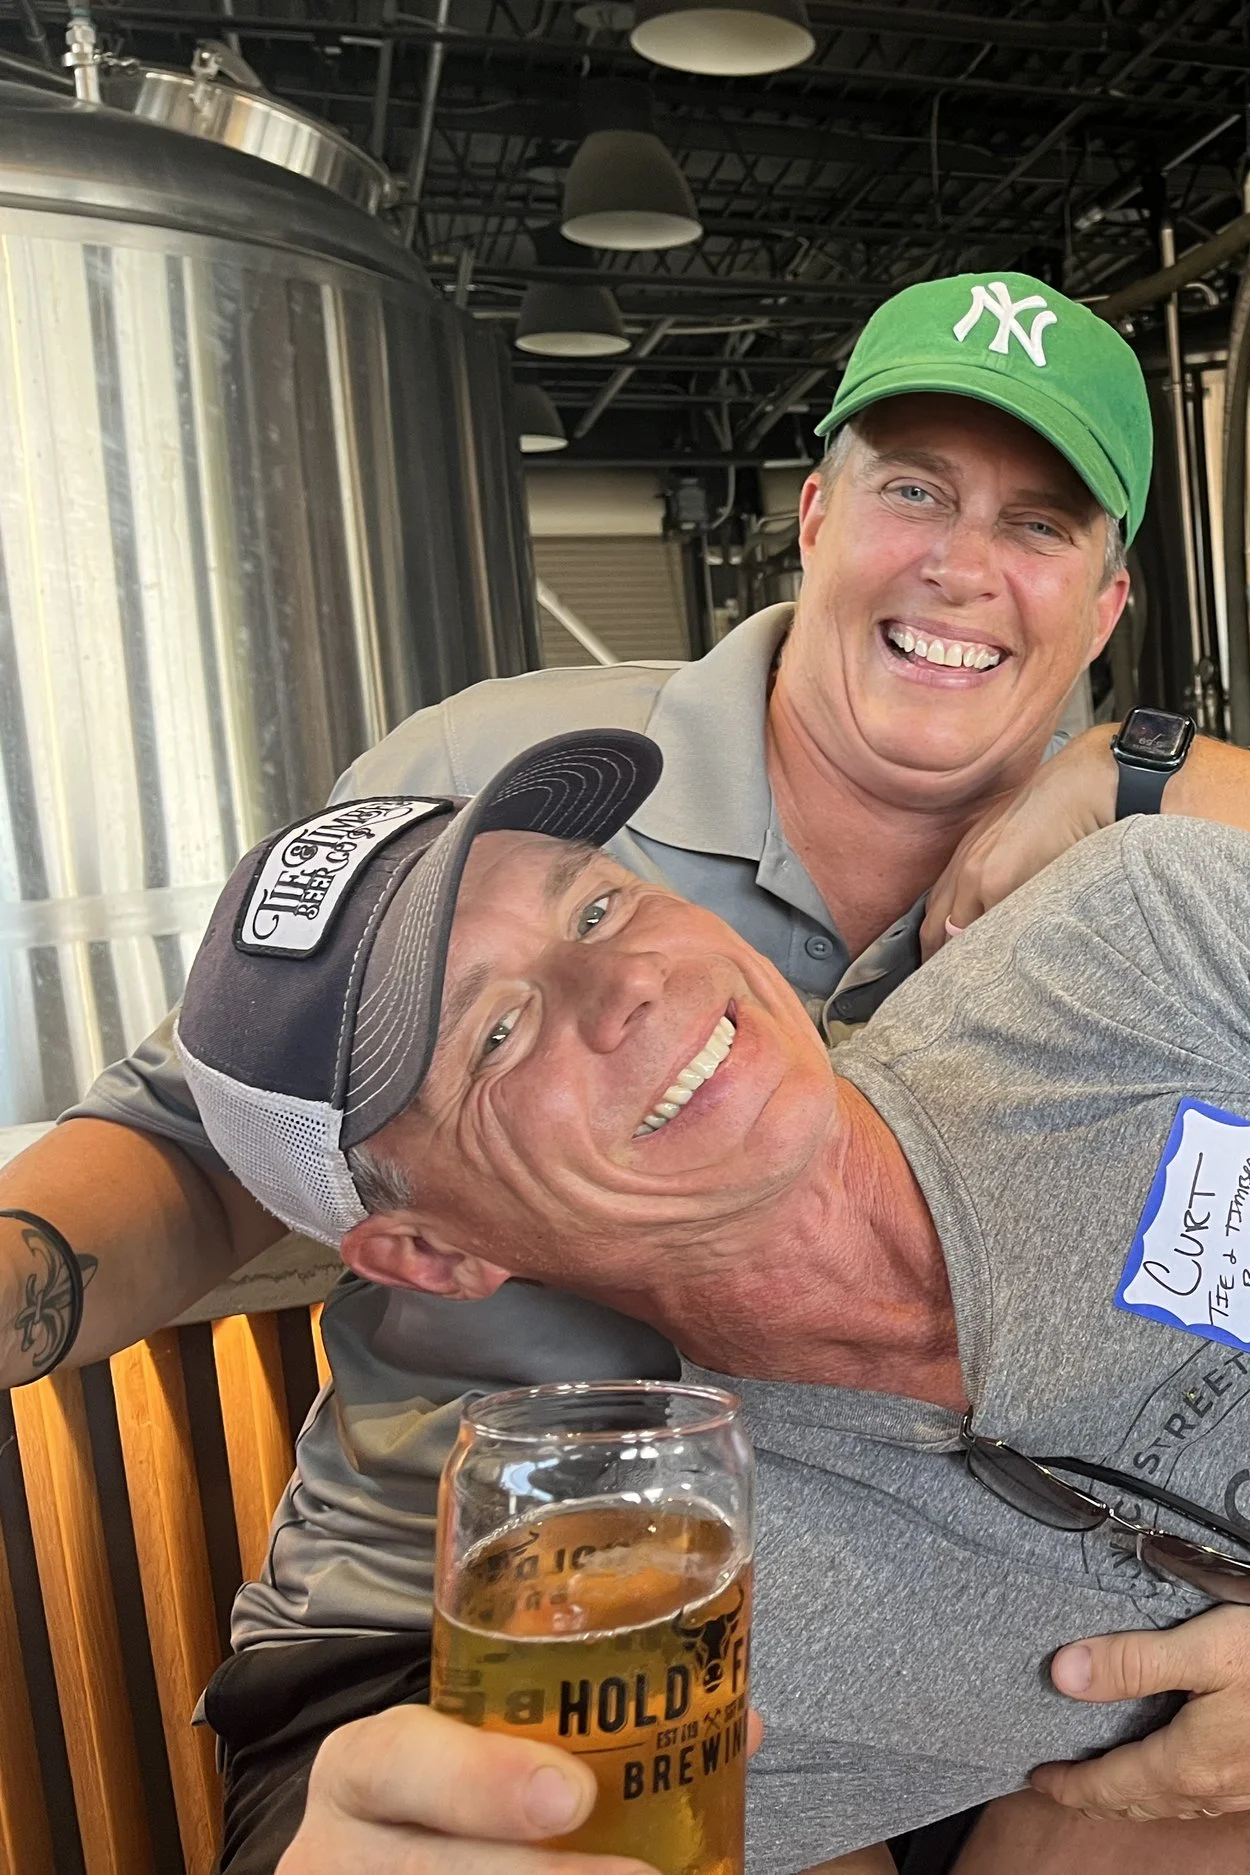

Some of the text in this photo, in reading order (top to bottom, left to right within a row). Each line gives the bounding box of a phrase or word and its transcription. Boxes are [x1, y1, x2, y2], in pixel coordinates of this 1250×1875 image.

[952, 281, 1058, 367] NY
[253, 870, 313, 940] TIE
[297, 866, 338, 920] BEER
[1142, 1152, 1216, 1296] CURT
[1133, 1351, 1249, 1476] STREET
[559, 1663, 691, 1736] HOLD
